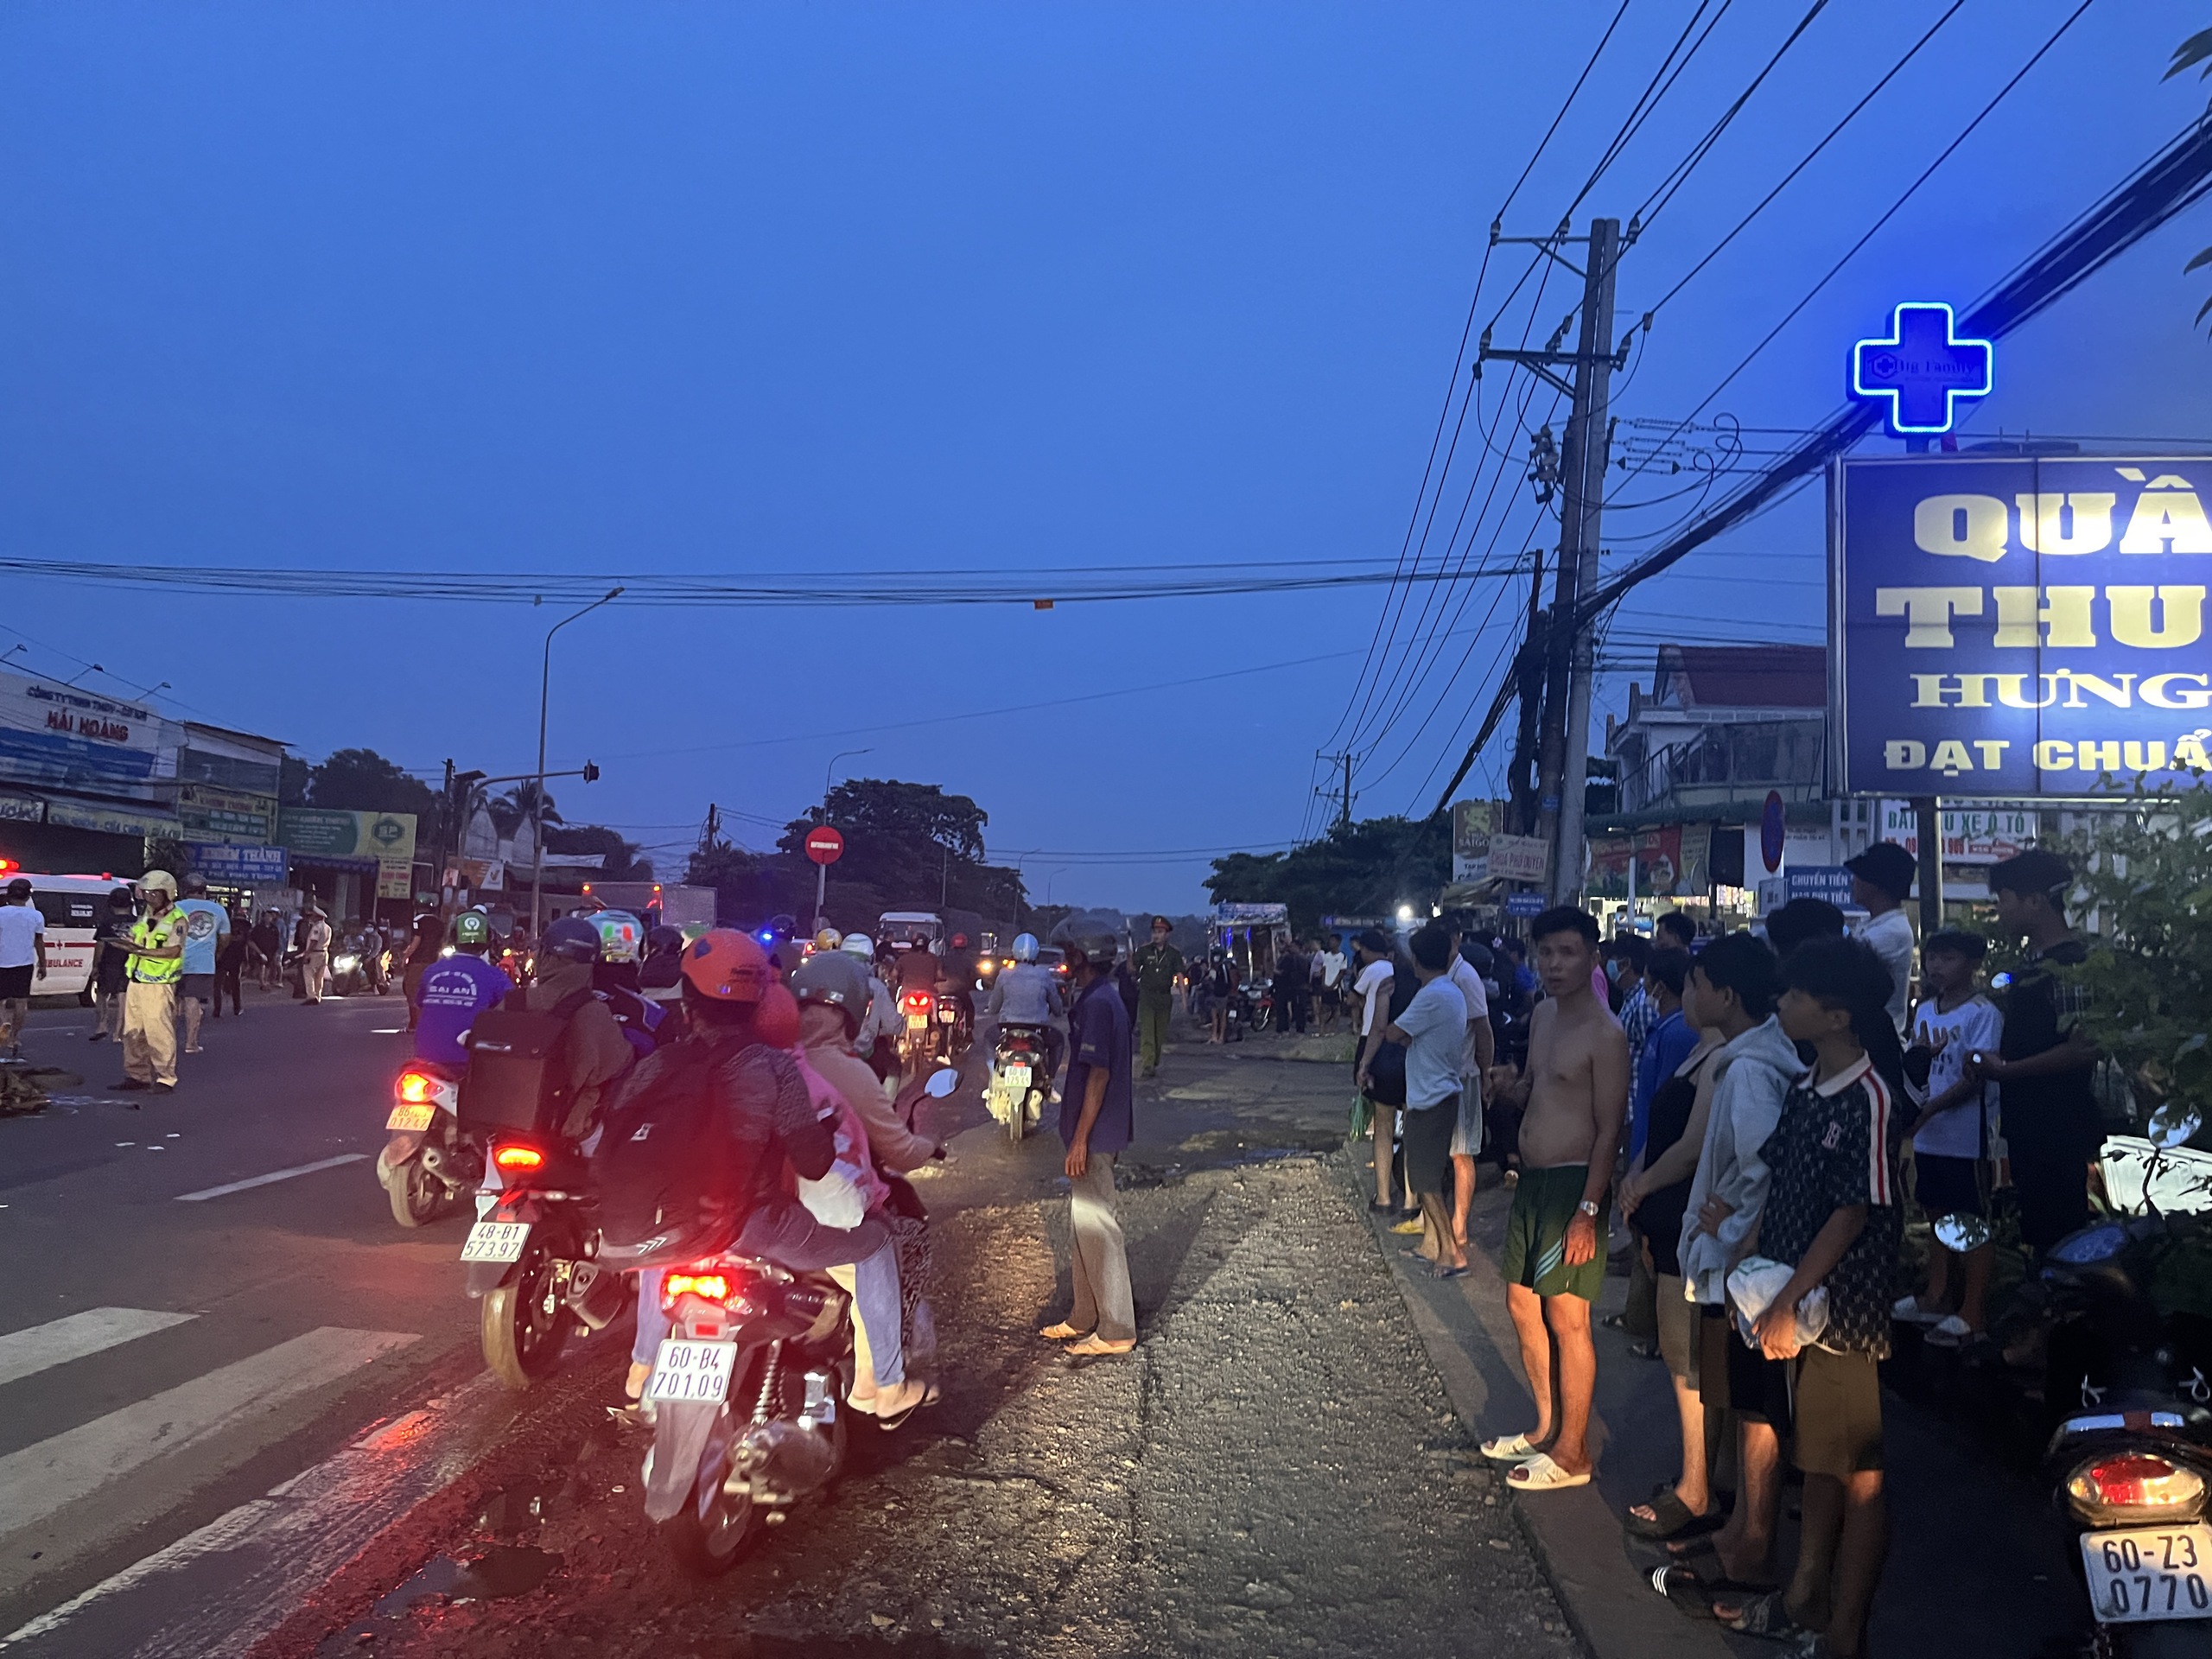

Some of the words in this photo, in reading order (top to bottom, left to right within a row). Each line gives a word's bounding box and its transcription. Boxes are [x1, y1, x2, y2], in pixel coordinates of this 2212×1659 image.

[1876, 585, 2206, 649] THU
[1910, 668, 2212, 709] HƯNG
[1884, 740, 2010, 776] ĐẠT
[1459, 836, 1490, 848] SAIGO
[45, 958, 84, 968] BULANCE
[478, 1224, 520, 1240] 48-B1
[465, 1241, 520, 1258] 573.97
[668, 1346, 721, 1371] 60-B4
[653, 1371, 724, 1398] 701.09
[2102, 1535, 2198, 1573] 60-Z3
[2110, 1573, 2209, 1613] 0770
